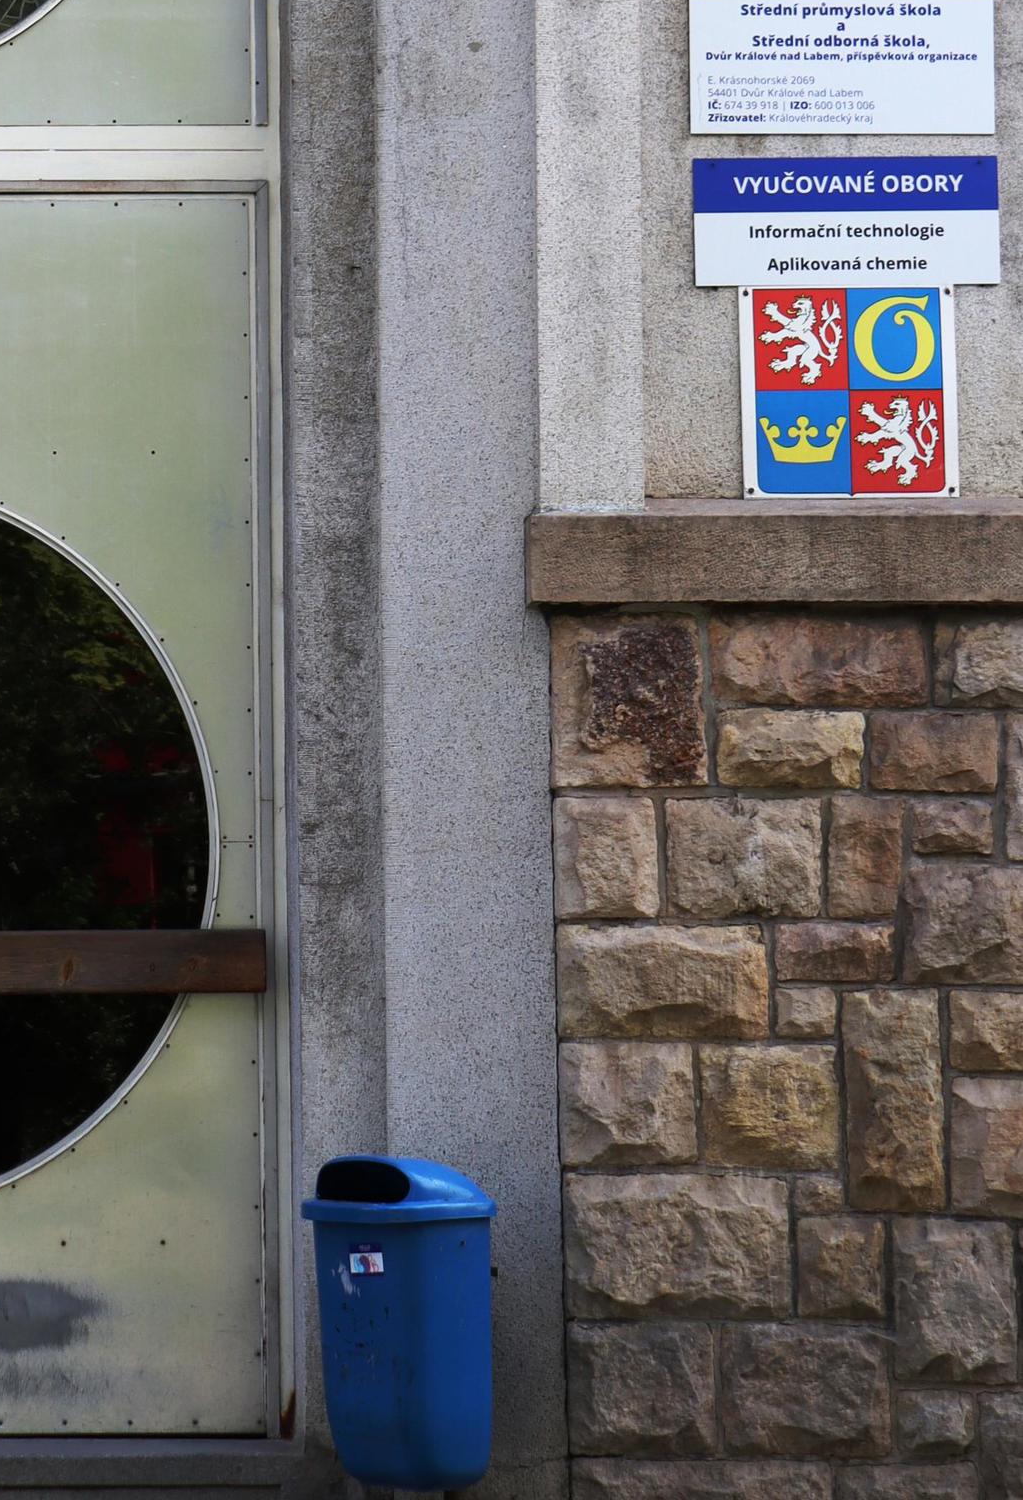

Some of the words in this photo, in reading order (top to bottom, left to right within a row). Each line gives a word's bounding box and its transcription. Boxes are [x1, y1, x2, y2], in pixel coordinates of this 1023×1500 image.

[740, 3, 798, 16] Střední
[802, 2, 895, 19] průmyslová
[899, 3, 942, 16] škola
[836, 22, 846, 31] a
[752, 34, 810, 47] Střední
[813, 34, 879, 47] odborná
[883, 34, 930, 49] škola,
[705, 50, 732, 61] Dvůr
[735, 51, 777, 61] Králové
[780, 51, 801, 61] nad
[803, 51, 844, 62] Labem,
[846, 51, 915, 62] příspěvková
[917, 51, 978, 62] organizace
[707, 76, 716, 85] E.
[719, 75, 788, 85] Krásnohorské
[790, 76, 815, 85] 2069
[707, 88, 737, 97] 54401
[740, 87, 765, 97] Dvůr
[767, 88, 805, 97] Králové
[807, 88, 827, 97] nad
[829, 88, 864, 98] Labem
[707, 99, 722, 110] IČ:
[724, 101, 743, 110] 674
[746, 101, 758, 110] 39
[760, 101, 779, 110] 918
[790, 101, 812, 110] IZO:
[814, 100, 833, 110] 600
[835, 100, 854, 110] 013
[856, 100, 875, 110] 006
[707, 113, 767, 123] Zřizovatel:
[769, 113, 852, 125] Královéhradecký
[854, 114, 873, 125] kraj
[733, 171, 876, 195] VYUČOVANÉ
[881, 174, 964, 193] OBORY
[749, 223, 842, 239] Informační
[846, 223, 945, 241] technologie
[767, 256, 862, 275] Aplikovaná
[866, 255, 928, 271] chemie
